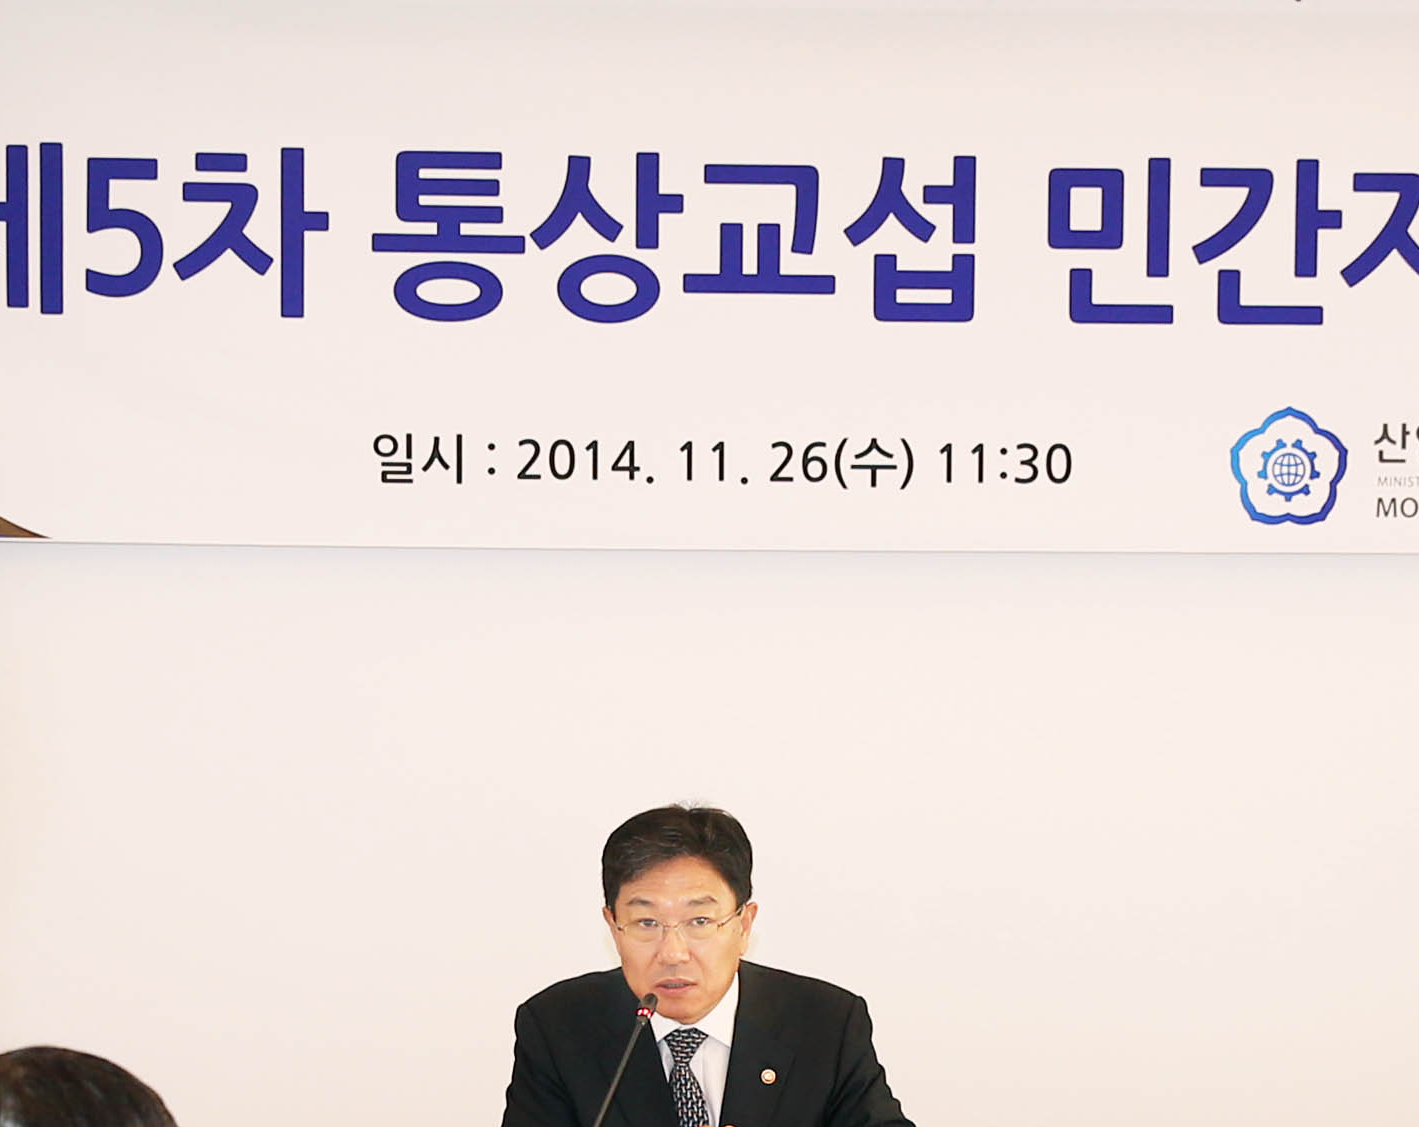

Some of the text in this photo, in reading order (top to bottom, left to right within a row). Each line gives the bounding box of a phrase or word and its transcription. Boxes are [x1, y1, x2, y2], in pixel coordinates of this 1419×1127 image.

[372, 151, 976, 324] 통상교섭
[373, 433, 462, 484] 일시
[517, 439, 654, 484] 2014.
[680, 441, 748, 485] 11.
[770, 438, 914, 490] 26(수)
[940, 443, 1072, 484] 11:30
